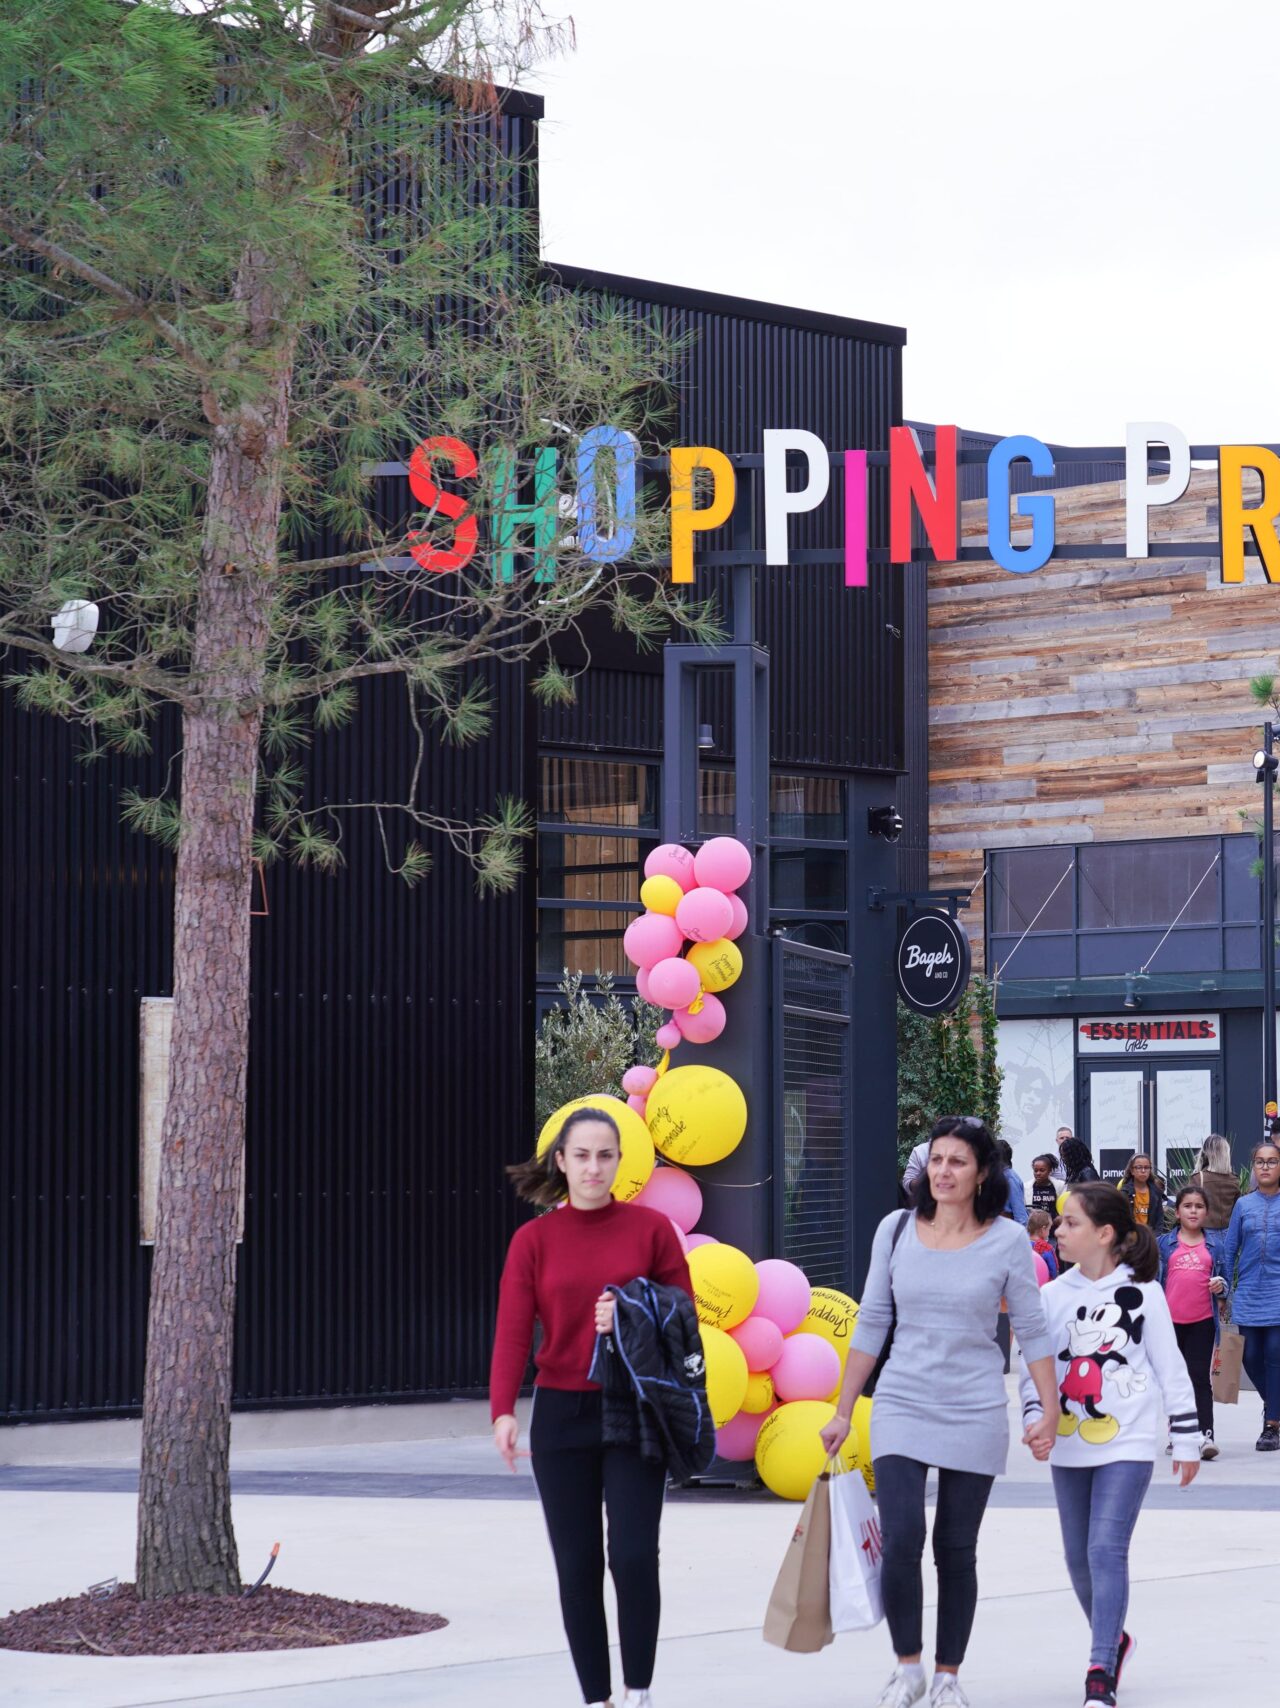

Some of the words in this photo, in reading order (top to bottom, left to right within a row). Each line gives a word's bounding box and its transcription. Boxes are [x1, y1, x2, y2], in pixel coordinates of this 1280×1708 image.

[408, 424, 1055, 586] SHOPPING
[905, 943, 954, 978] Bagels
[1090, 1020, 1210, 1040] ESSENTIALS
